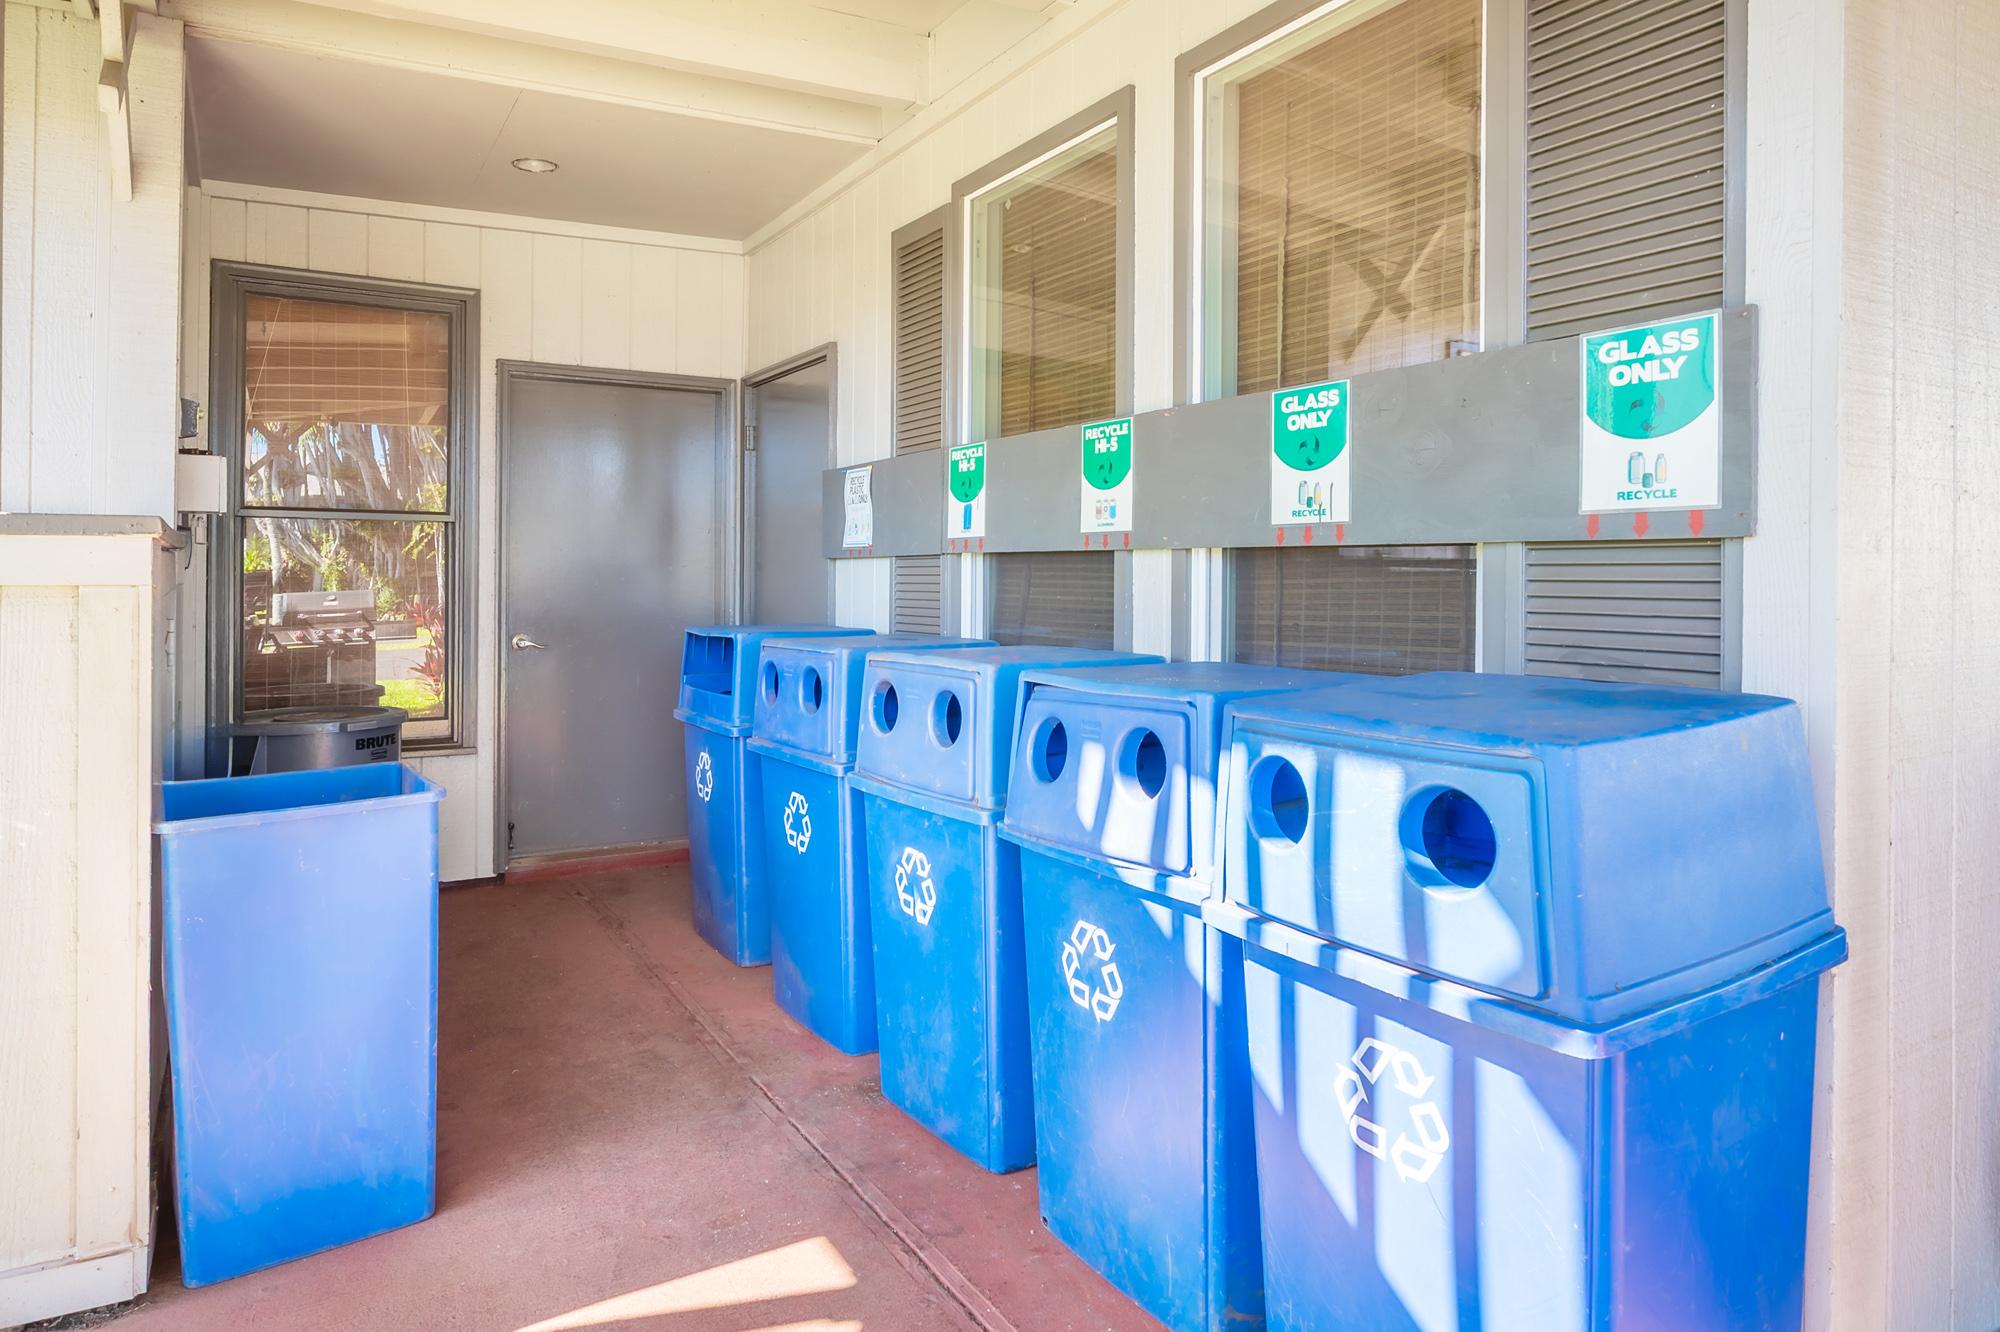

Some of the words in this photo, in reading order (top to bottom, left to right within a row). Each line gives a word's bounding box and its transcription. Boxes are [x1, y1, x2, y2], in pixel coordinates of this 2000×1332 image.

[1598, 327, 1700, 364] GLASS
[1608, 355, 1688, 387] ONLY
[1281, 389, 1340, 413] GLASS
[1287, 409, 1333, 431] ONLY
[1085, 422, 1129, 440] RECYCLE
[952, 446, 983, 461] RECYCLE
[1094, 436, 1119, 454] HI-5
[958, 458, 976, 473] HI-5
[850, 485, 865, 496] PLASTIC
[1617, 488, 1678, 501] RECYCLE
[1291, 508, 1327, 517] RECYCLE
[355, 733, 396, 751] BRUTE
